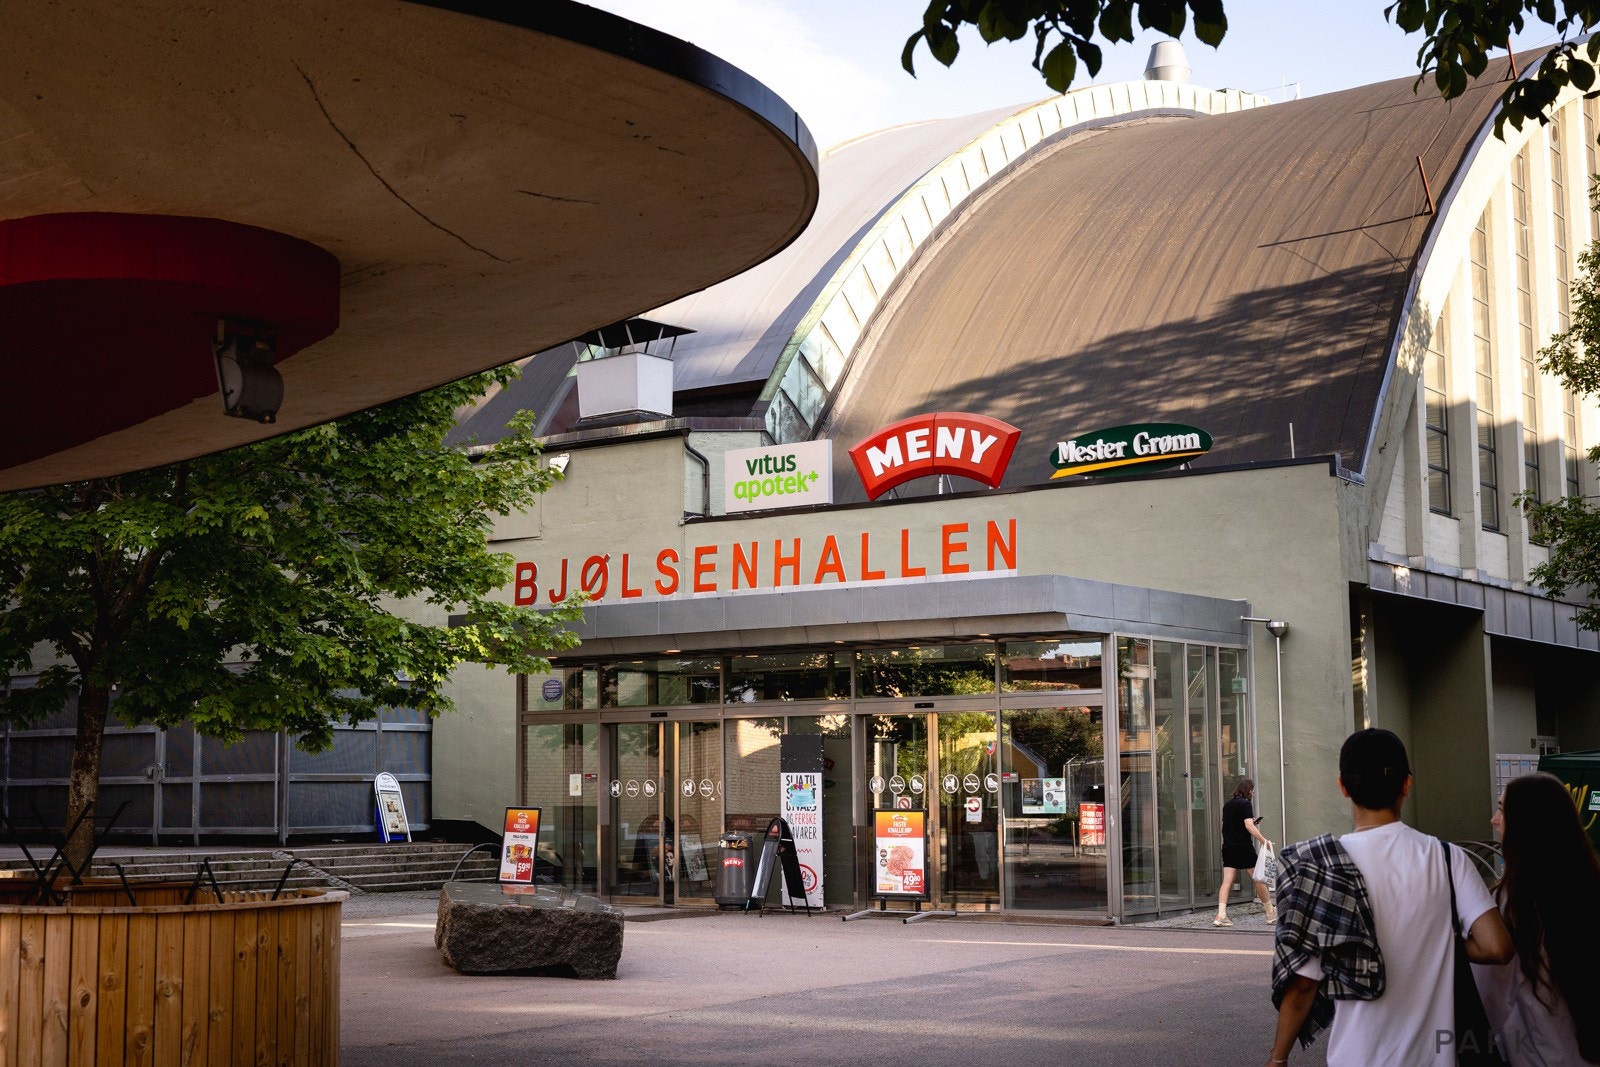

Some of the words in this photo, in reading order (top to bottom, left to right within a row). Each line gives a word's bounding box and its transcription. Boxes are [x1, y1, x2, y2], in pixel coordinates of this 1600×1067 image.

[865, 425, 998, 478] MENY
[1056, 438, 1128, 464] Mester
[1132, 431, 1202, 456] Grønn
[745, 453, 797, 476] vitus
[514, 518, 1017, 606] BJØLSENHALLEN
[795, 813, 817, 825] FERSKE
